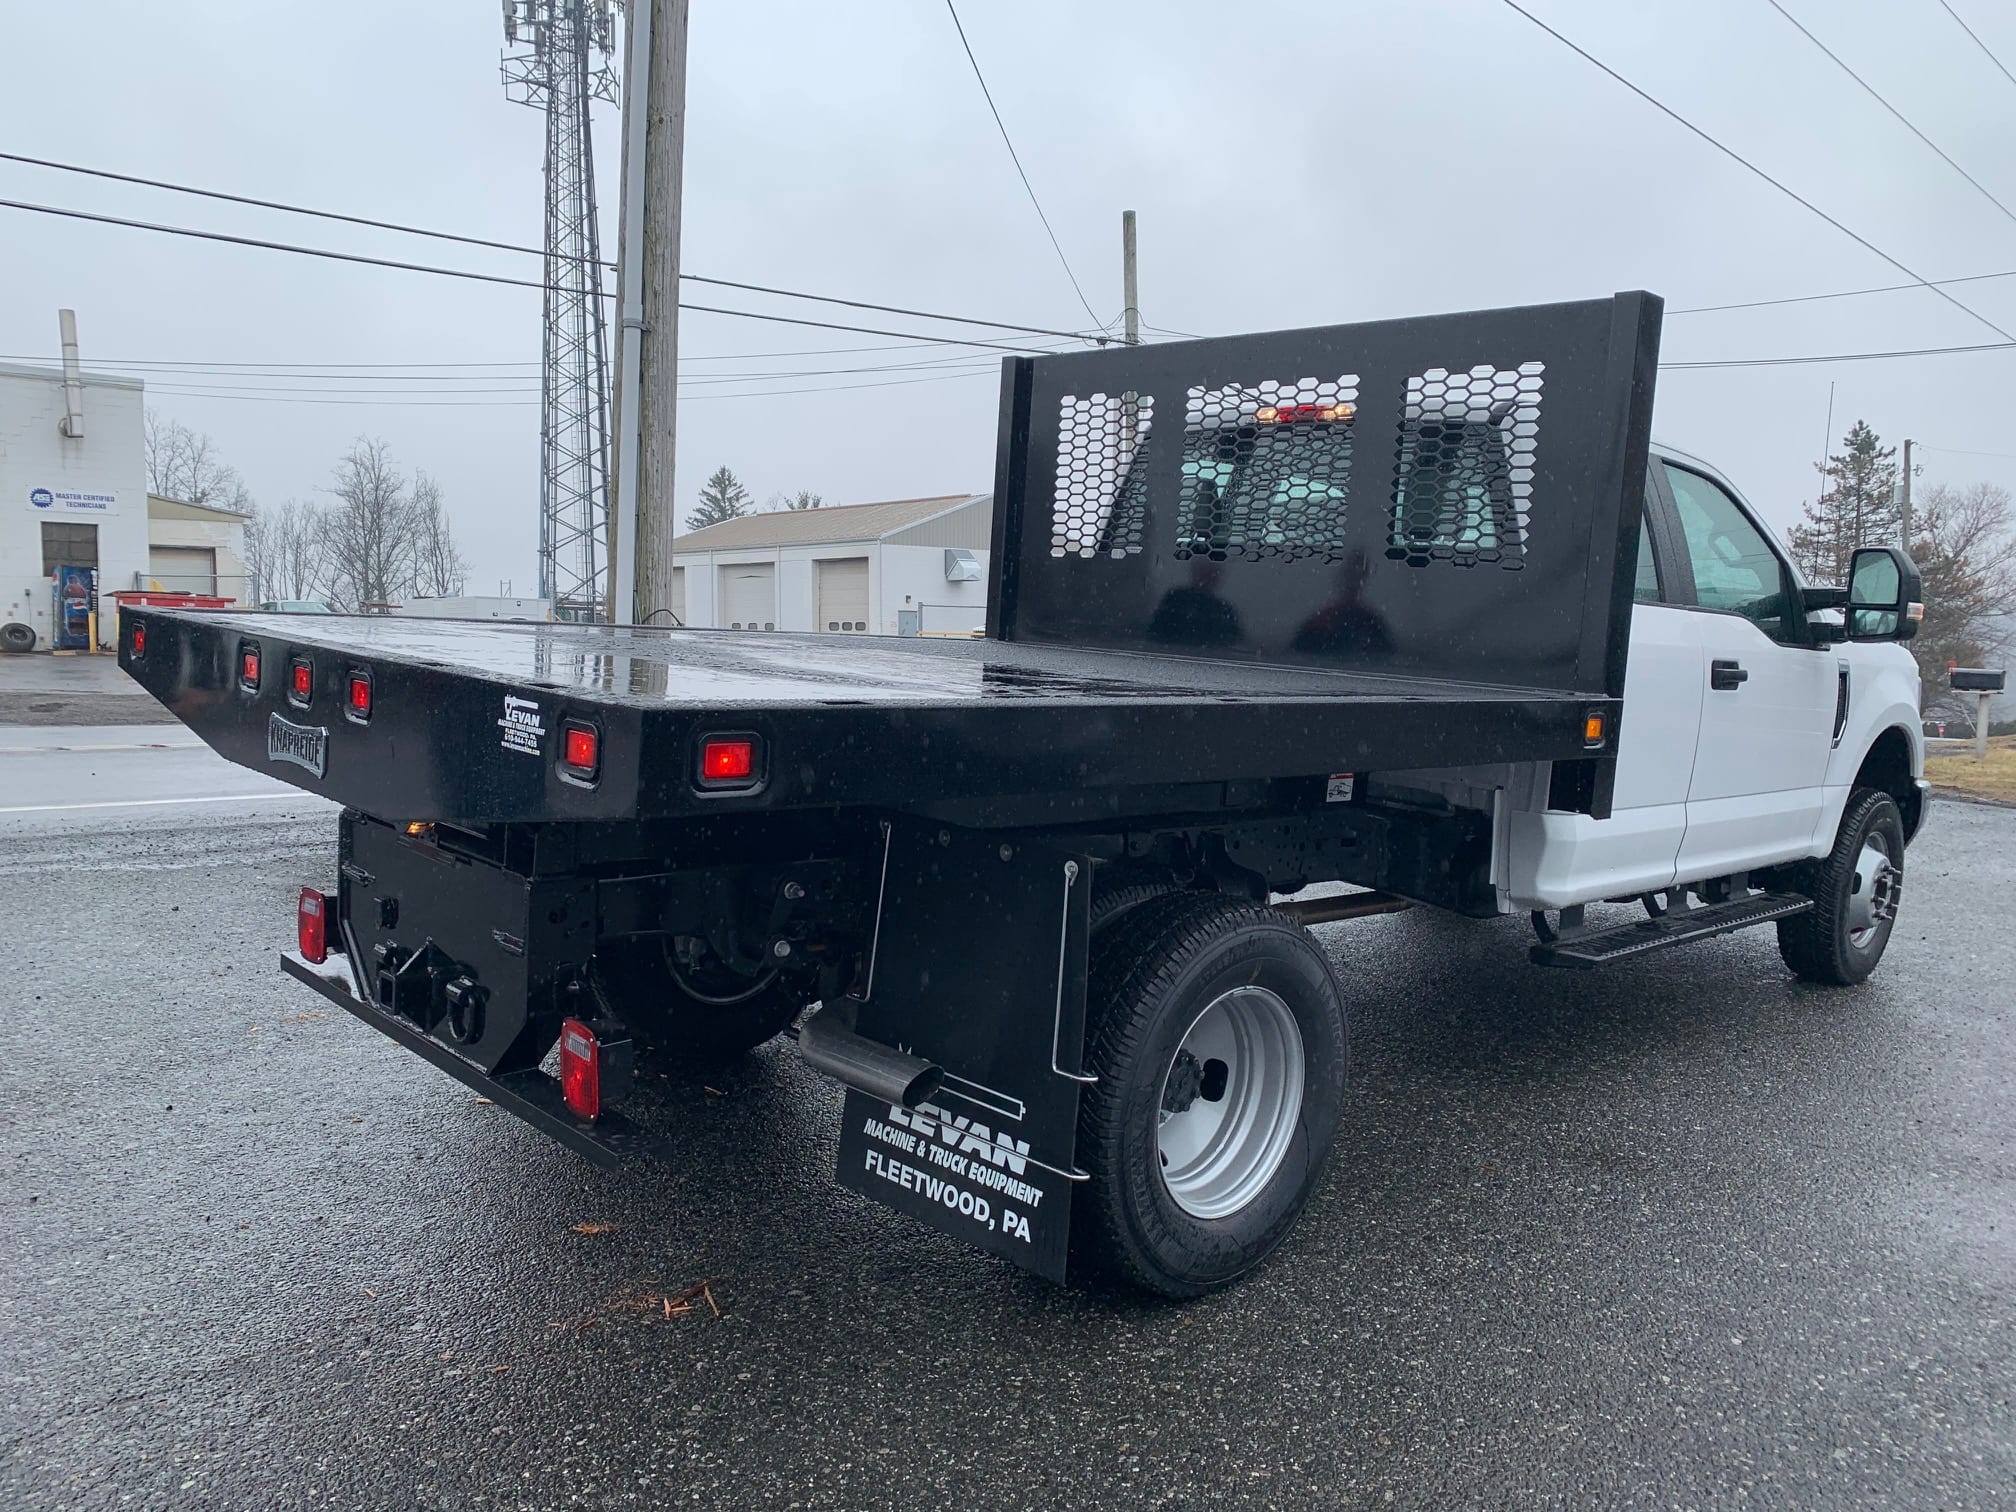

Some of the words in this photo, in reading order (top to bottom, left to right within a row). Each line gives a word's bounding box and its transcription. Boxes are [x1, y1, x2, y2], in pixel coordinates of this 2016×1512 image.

[55, 492, 82, 500] MASTER
[83, 494, 115, 502] CERTIFIED
[65, 501, 107, 509] TECHNICIANS
[505, 709, 540, 727] LEVAN
[270, 721, 321, 770] KNAPHEIDE
[863, 1118, 917, 1153] MACHINE
[916, 1139, 927, 1158] &
[928, 1143, 969, 1176] TRUCK
[968, 1162, 1044, 1208] EQUIPMENT
[864, 1149, 996, 1231] FLEETWOOD,
[1002, 1208, 1032, 1243] PA
